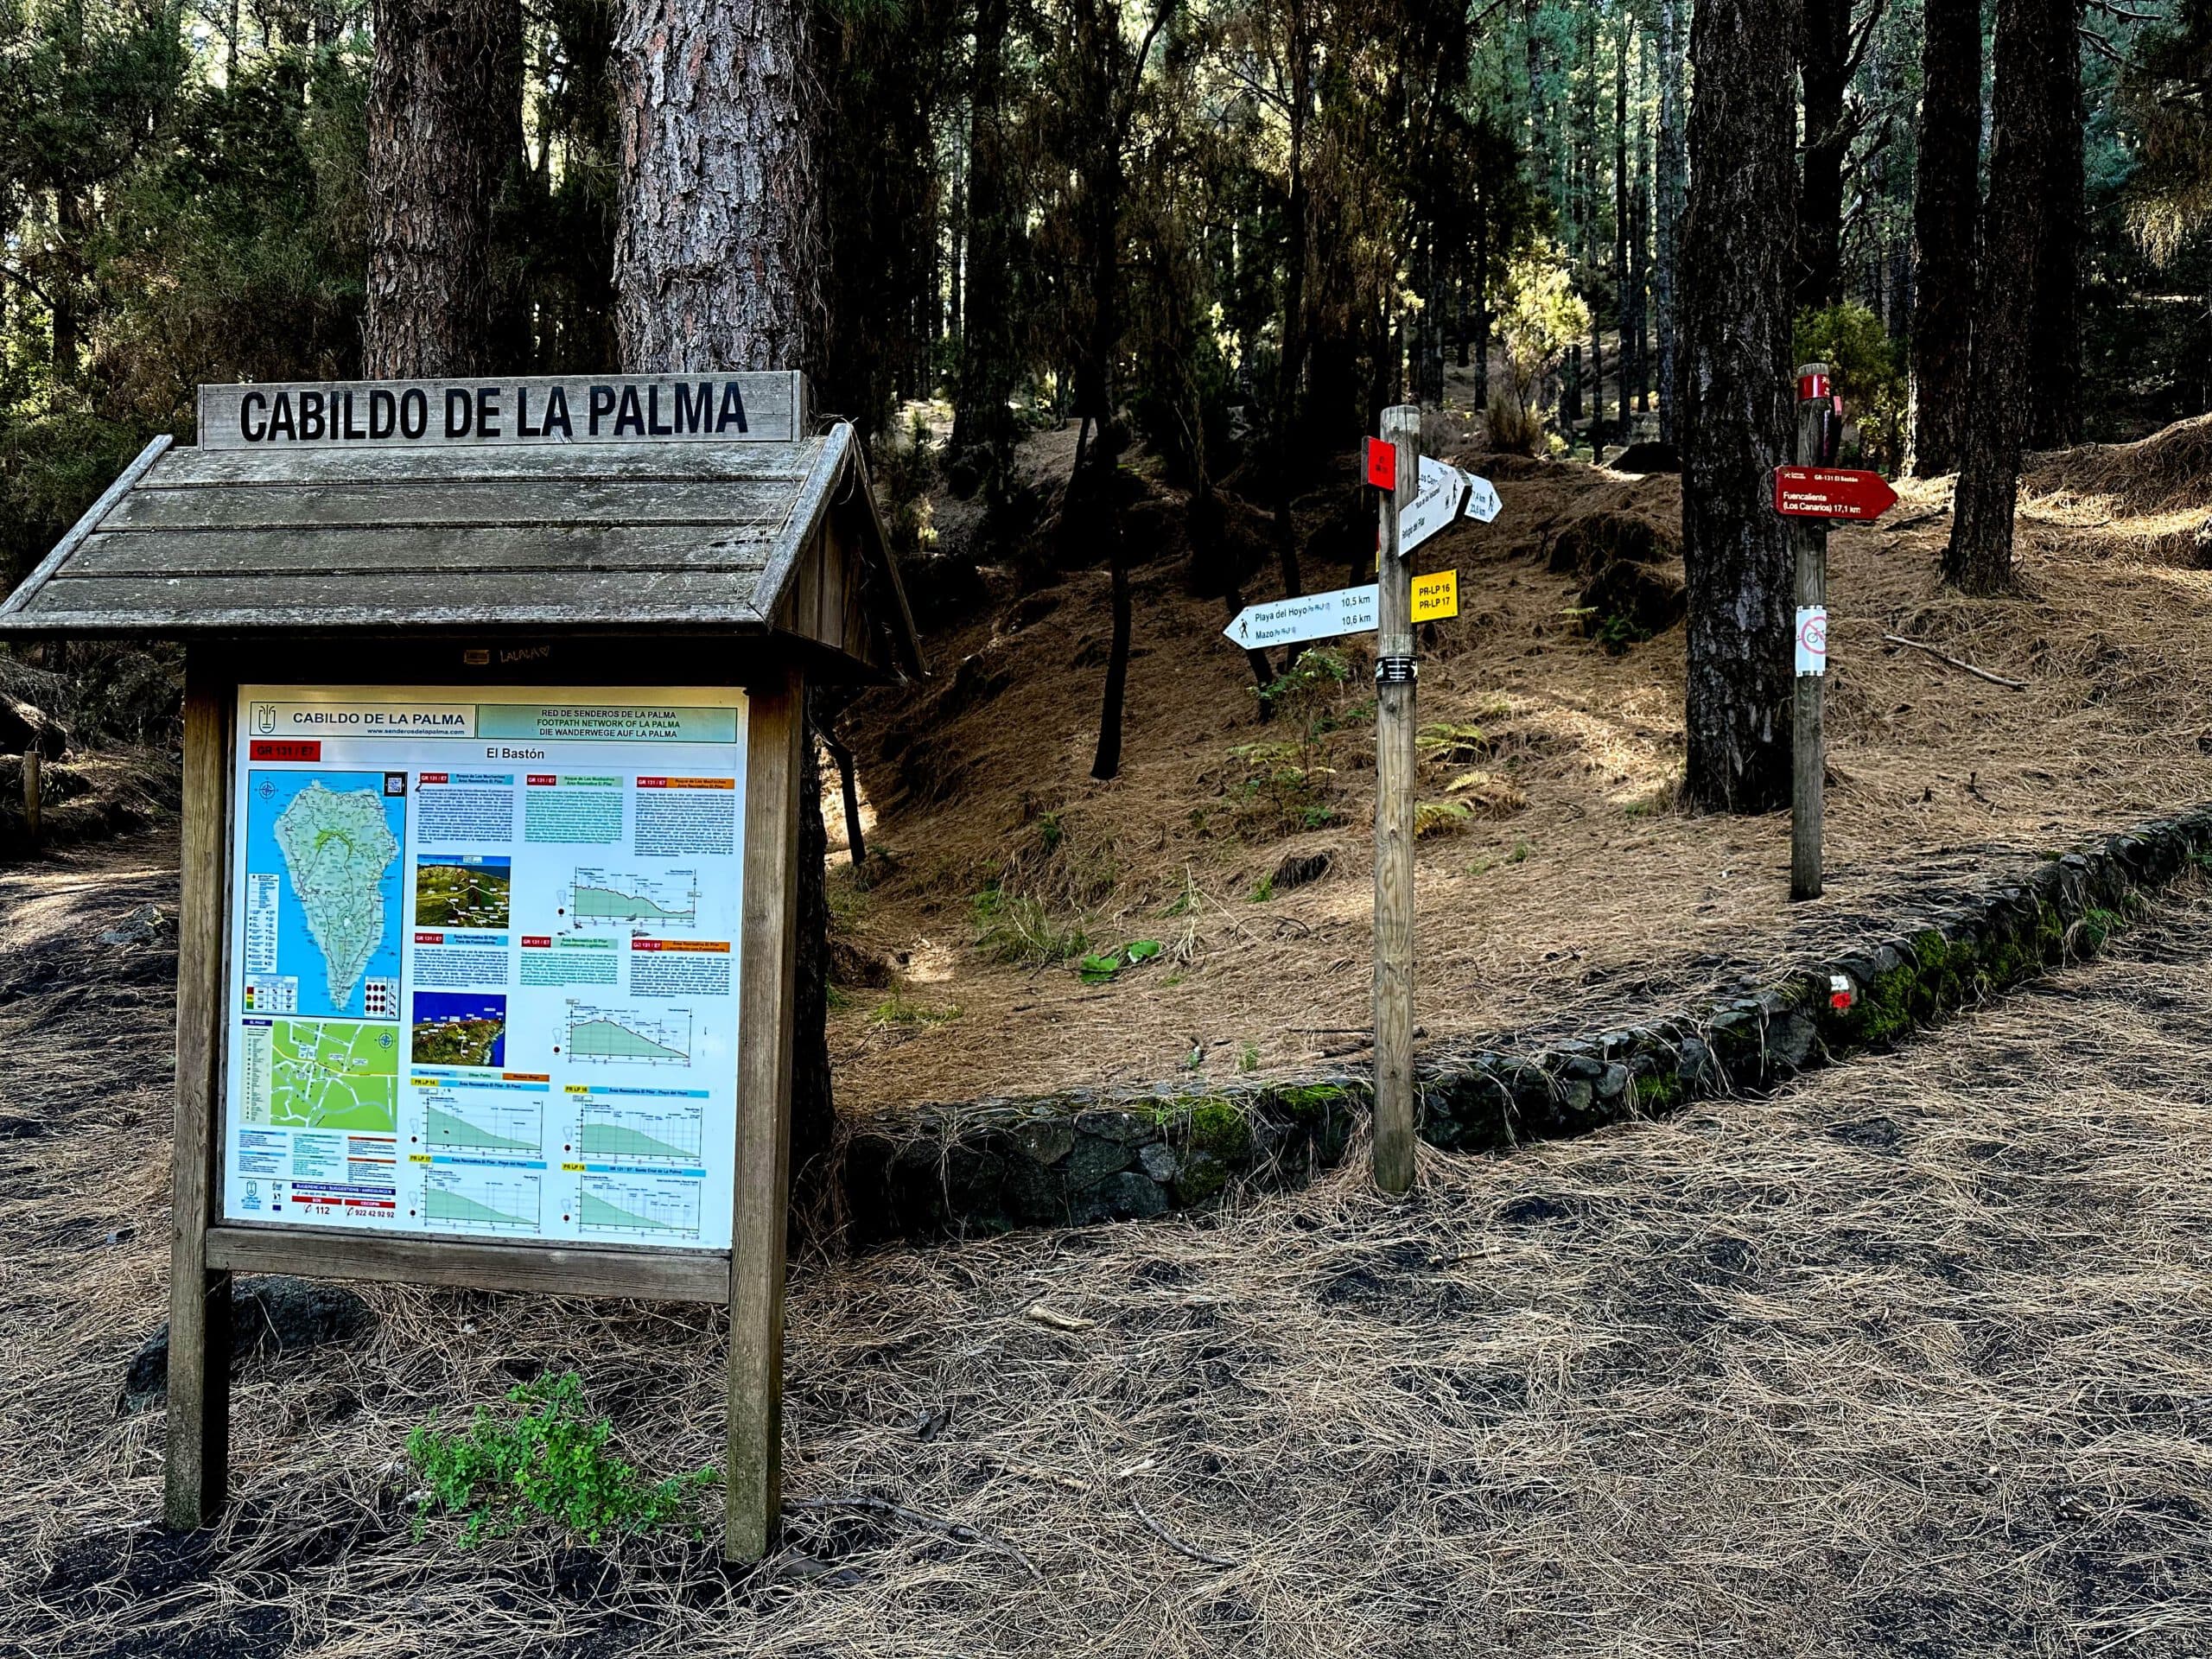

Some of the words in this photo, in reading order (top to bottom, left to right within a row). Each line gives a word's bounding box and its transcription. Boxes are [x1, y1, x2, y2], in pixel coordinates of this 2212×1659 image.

[240, 389, 428, 442] CABILDO
[445, 387, 500, 439] DE
[518, 386, 574, 438] LA
[590, 382, 749, 436] PALMA
[1783, 491, 1827, 501] Fuencaliente
[1783, 501, 1798, 511] (Los
[1799, 502, 1833, 513] Canarios)
[1834, 505, 1848, 513] 17,1
[1419, 585, 1440, 596] PR-LP
[1442, 583, 1451, 593] 16
[1341, 596, 1357, 608] 10,5
[1358, 594, 1370, 604] km
[1419, 598, 1440, 610] PR-LP
[1442, 596, 1450, 606] 17
[1255, 612, 1274, 622] Playa
[1275, 609, 1287, 620] del
[1288, 607, 1307, 618] Hoyo
[1342, 615, 1357, 626] 10,6
[1359, 614, 1371, 623] km
[1255, 629, 1274, 640] Mazo
[293, 712, 359, 724] CABILDO
[364, 713, 385, 724] DE
[389, 714, 409, 725] LA
[413, 714, 465, 725] PALMA
[561, 709, 573, 718] DE
[573, 709, 620, 718] SENDEROS
[537, 718, 580, 727] FOOTPATH
[582, 719, 623, 728] NETWORK
[257, 746, 273, 755] GR
[276, 746, 292, 756] 131
[302, 746, 315, 756] E7
[486, 747, 499, 760] El
[502, 747, 545, 760] Bastón
[315, 1206, 330, 1215] 112
